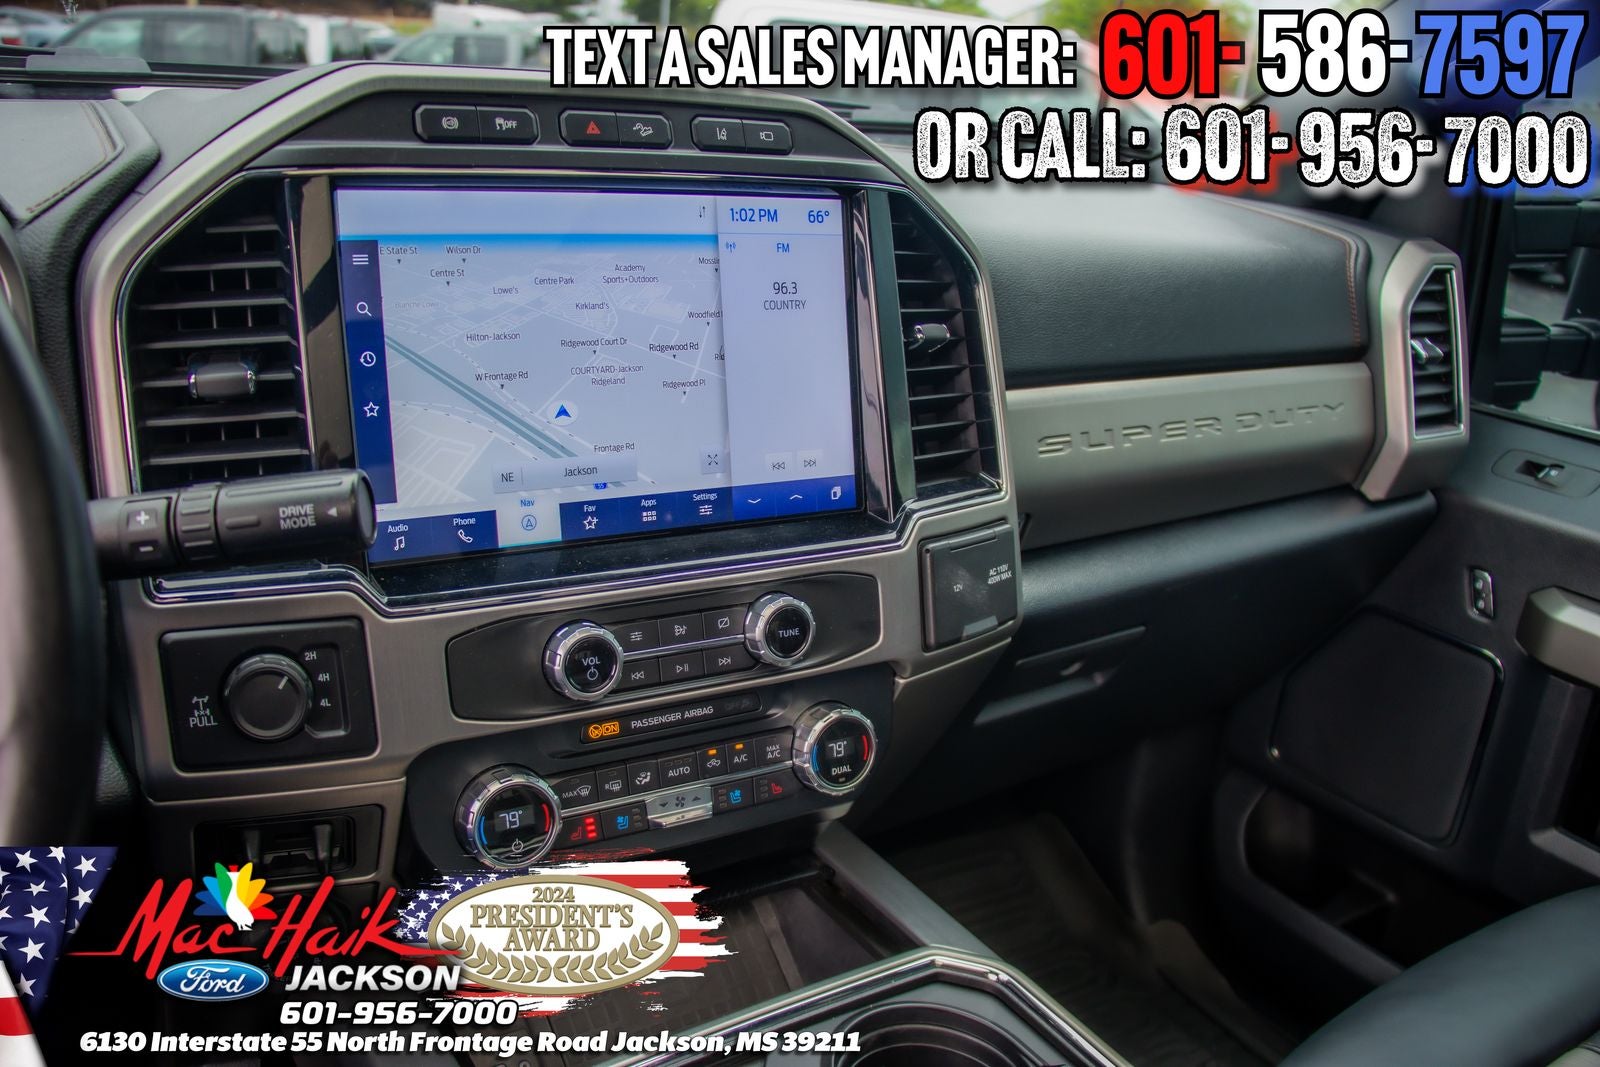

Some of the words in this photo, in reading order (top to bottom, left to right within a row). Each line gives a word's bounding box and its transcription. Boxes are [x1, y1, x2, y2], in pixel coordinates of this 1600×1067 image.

[504, 120, 518, 129] OFF
[730, 208, 756, 222] 1:02
[758, 208, 778, 222] PM
[808, 210, 830, 224] 66°
[380, 246, 384, 254] E
[409, 246, 418, 254] St
[446, 246, 472, 254] Wilson
[473, 246, 481, 254] Dr
[777, 242, 790, 253] FM
[430, 269, 455, 278] Centre
[456, 268, 464, 277] St
[615, 264, 646, 273] Academy
[534, 278, 558, 286] Centre
[559, 277, 574, 285] Park
[602, 275, 659, 284] Sports+Outdoors
[493, 286, 518, 295] Lowe's
[773, 282, 798, 295] 96.3
[576, 302, 610, 310] Kirkland's
[764, 300, 807, 310] COUNTRY
[688, 310, 720, 319] Woodfield
[466, 332, 520, 342] Hilton-Jackson
[561, 338, 599, 349] Ridgewood
[600, 338, 618, 346] Court
[619, 338, 628, 346] Dr
[649, 342, 688, 352] Ridgewood
[690, 342, 699, 350] Rd
[570, 364, 644, 376] COURTYARD-Jackson
[475, 374, 484, 382] W
[484, 372, 518, 382] Frontage
[518, 371, 528, 380] Rd
[592, 377, 626, 386] Ridgeland
[662, 380, 698, 389] Ridgewood
[1037, 416, 1223, 459] SUPER
[1235, 402, 1345, 433] DUTY
[594, 443, 624, 453] Frontage
[626, 442, 635, 450] Rd
[501, 472, 514, 483] NE
[564, 466, 598, 478] Jackson
[692, 492, 718, 501] Settings
[520, 499, 535, 507] Nav
[584, 504, 596, 512] Fav
[640, 499, 657, 507] Apps
[278, 504, 315, 518] DRIVE
[280, 515, 316, 530] MODE
[453, 517, 476, 526] Phone
[388, 524, 408, 533] Audio
[989, 567, 996, 576] AC
[1001, 570, 1012, 580] MAX
[953, 584, 964, 592] 12V
[778, 628, 800, 638] TUNE
[304, 651, 317, 661] 2H
[582, 656, 601, 666] VOL
[318, 672, 330, 682] 4H
[320, 698, 332, 707] 4L
[189, 716, 218, 728] PULL
[604, 723, 618, 734] ON
[631, 712, 682, 729] PASSENGER
[684, 706, 714, 719] AIRBAG
[766, 744, 780, 752] MAX
[734, 754, 748, 764] A/C
[767, 750, 781, 760] A/C
[668, 766, 691, 778] AUTO
[832, 766, 852, 776] DUAL
[562, 790, 578, 799] MAX
